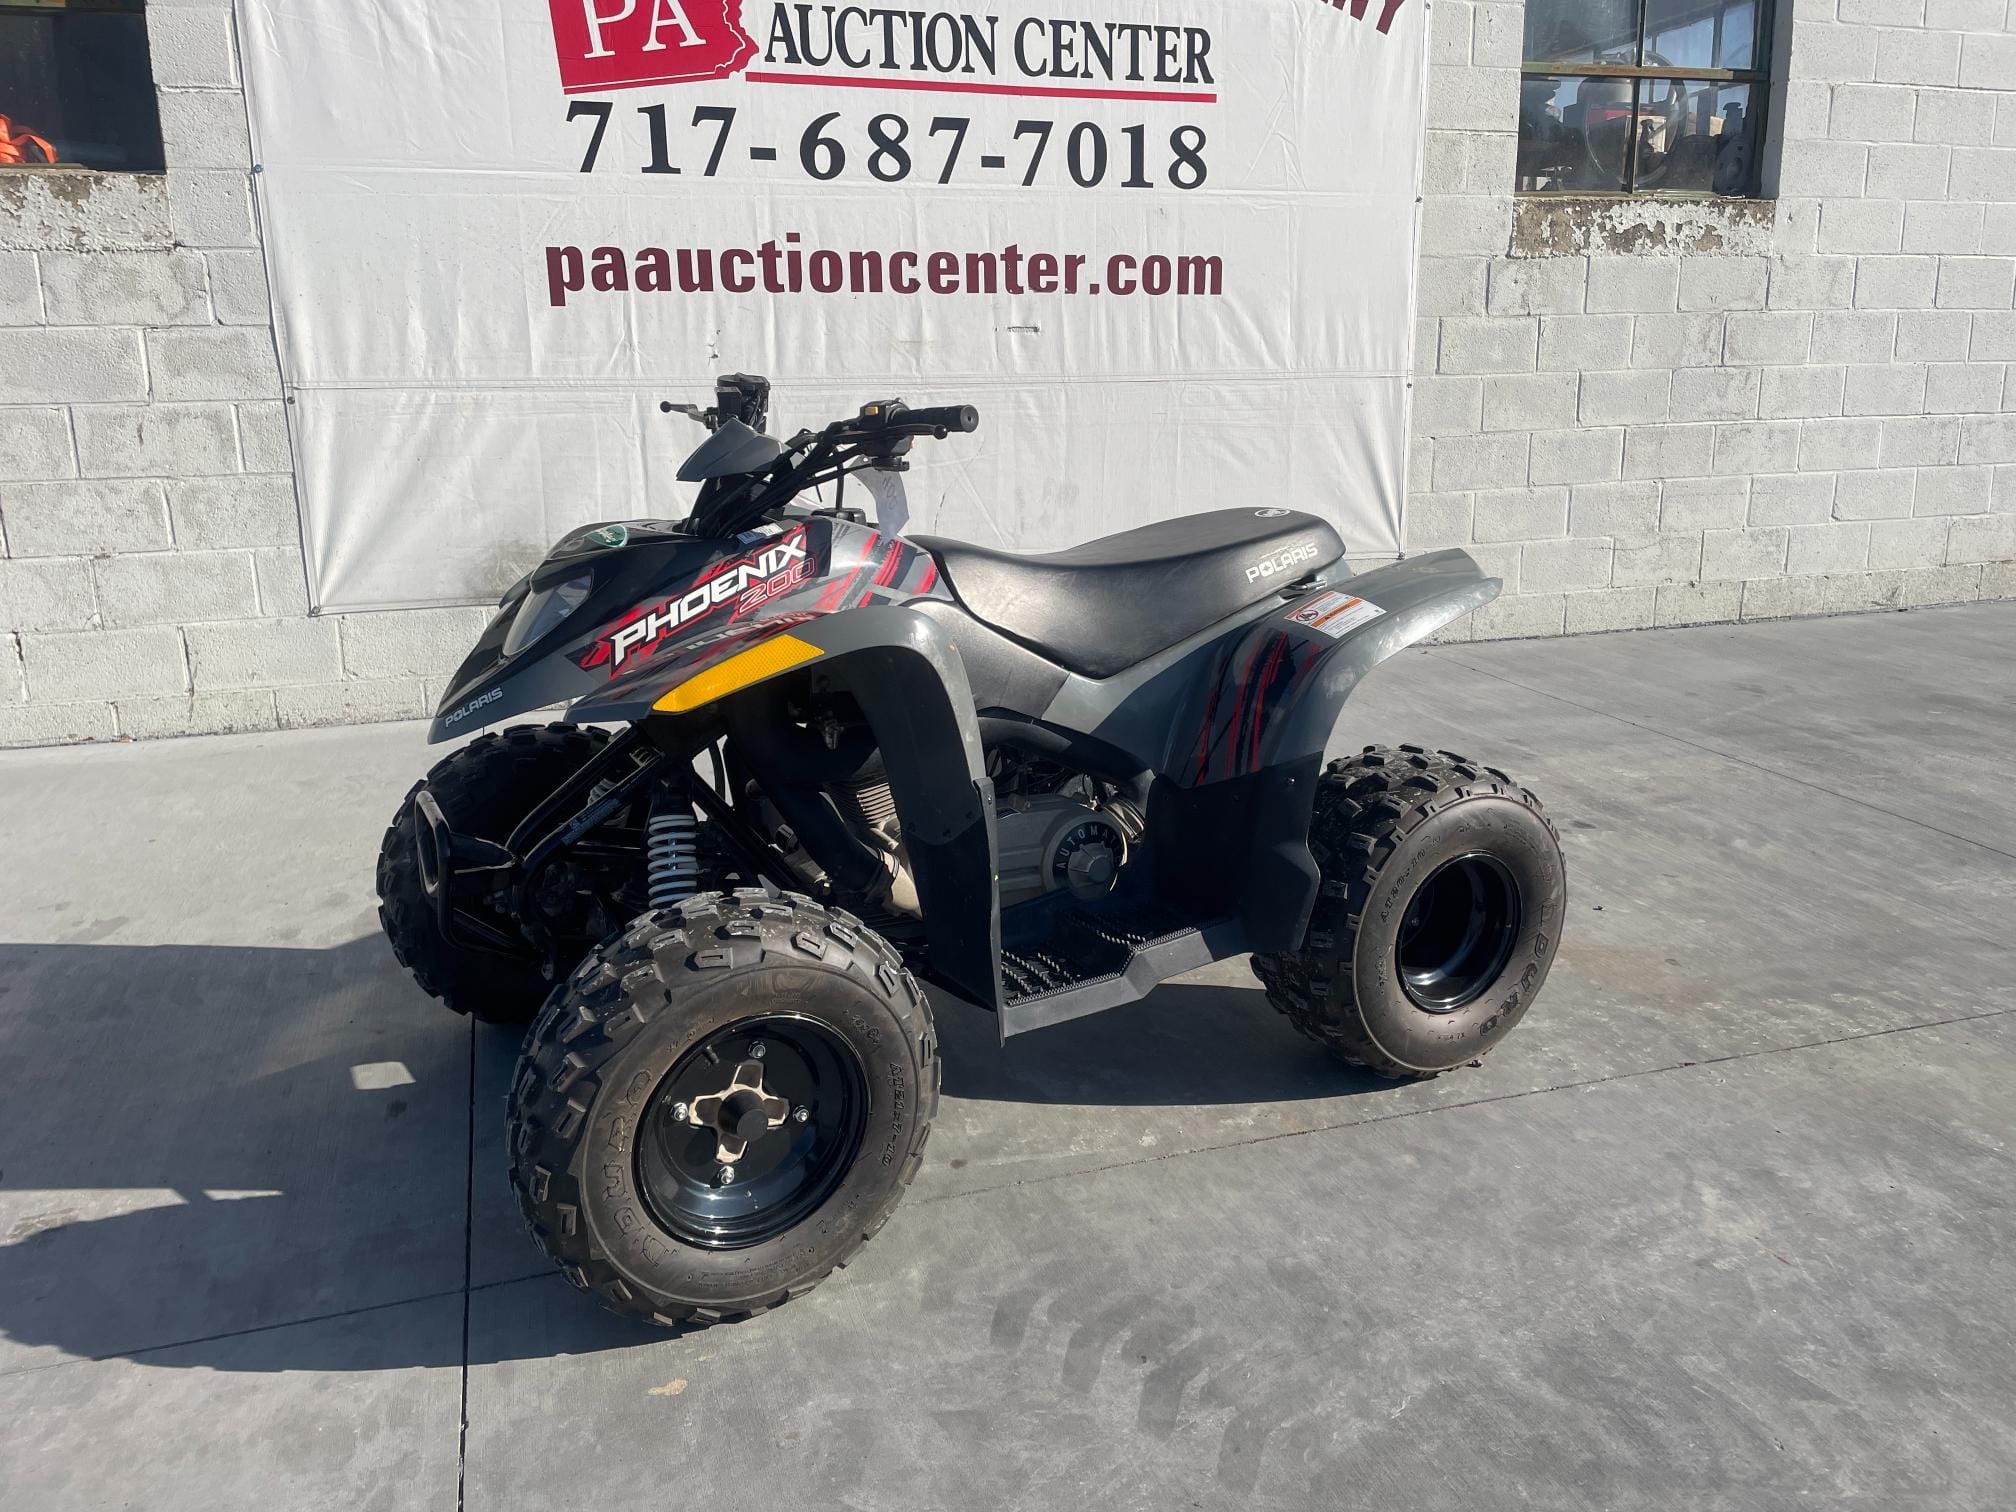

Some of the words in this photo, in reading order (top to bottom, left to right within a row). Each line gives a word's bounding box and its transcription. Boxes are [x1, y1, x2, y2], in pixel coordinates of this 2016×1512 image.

[583, 0, 706, 58] PA
[764, 2, 999, 76] AUCTION
[1014, 17, 1214, 84] CENTER
[566, 100, 1207, 189] 717-687-7018
[546, 232, 1223, 306] paauctioncenter.com
[739, 557, 815, 613] 200
[1245, 542, 1318, 584] POLARIS
[610, 534, 806, 666] PHOENIX
[445, 687, 503, 728] POLARIS
[1055, 825, 1120, 870] AUTOMAT
